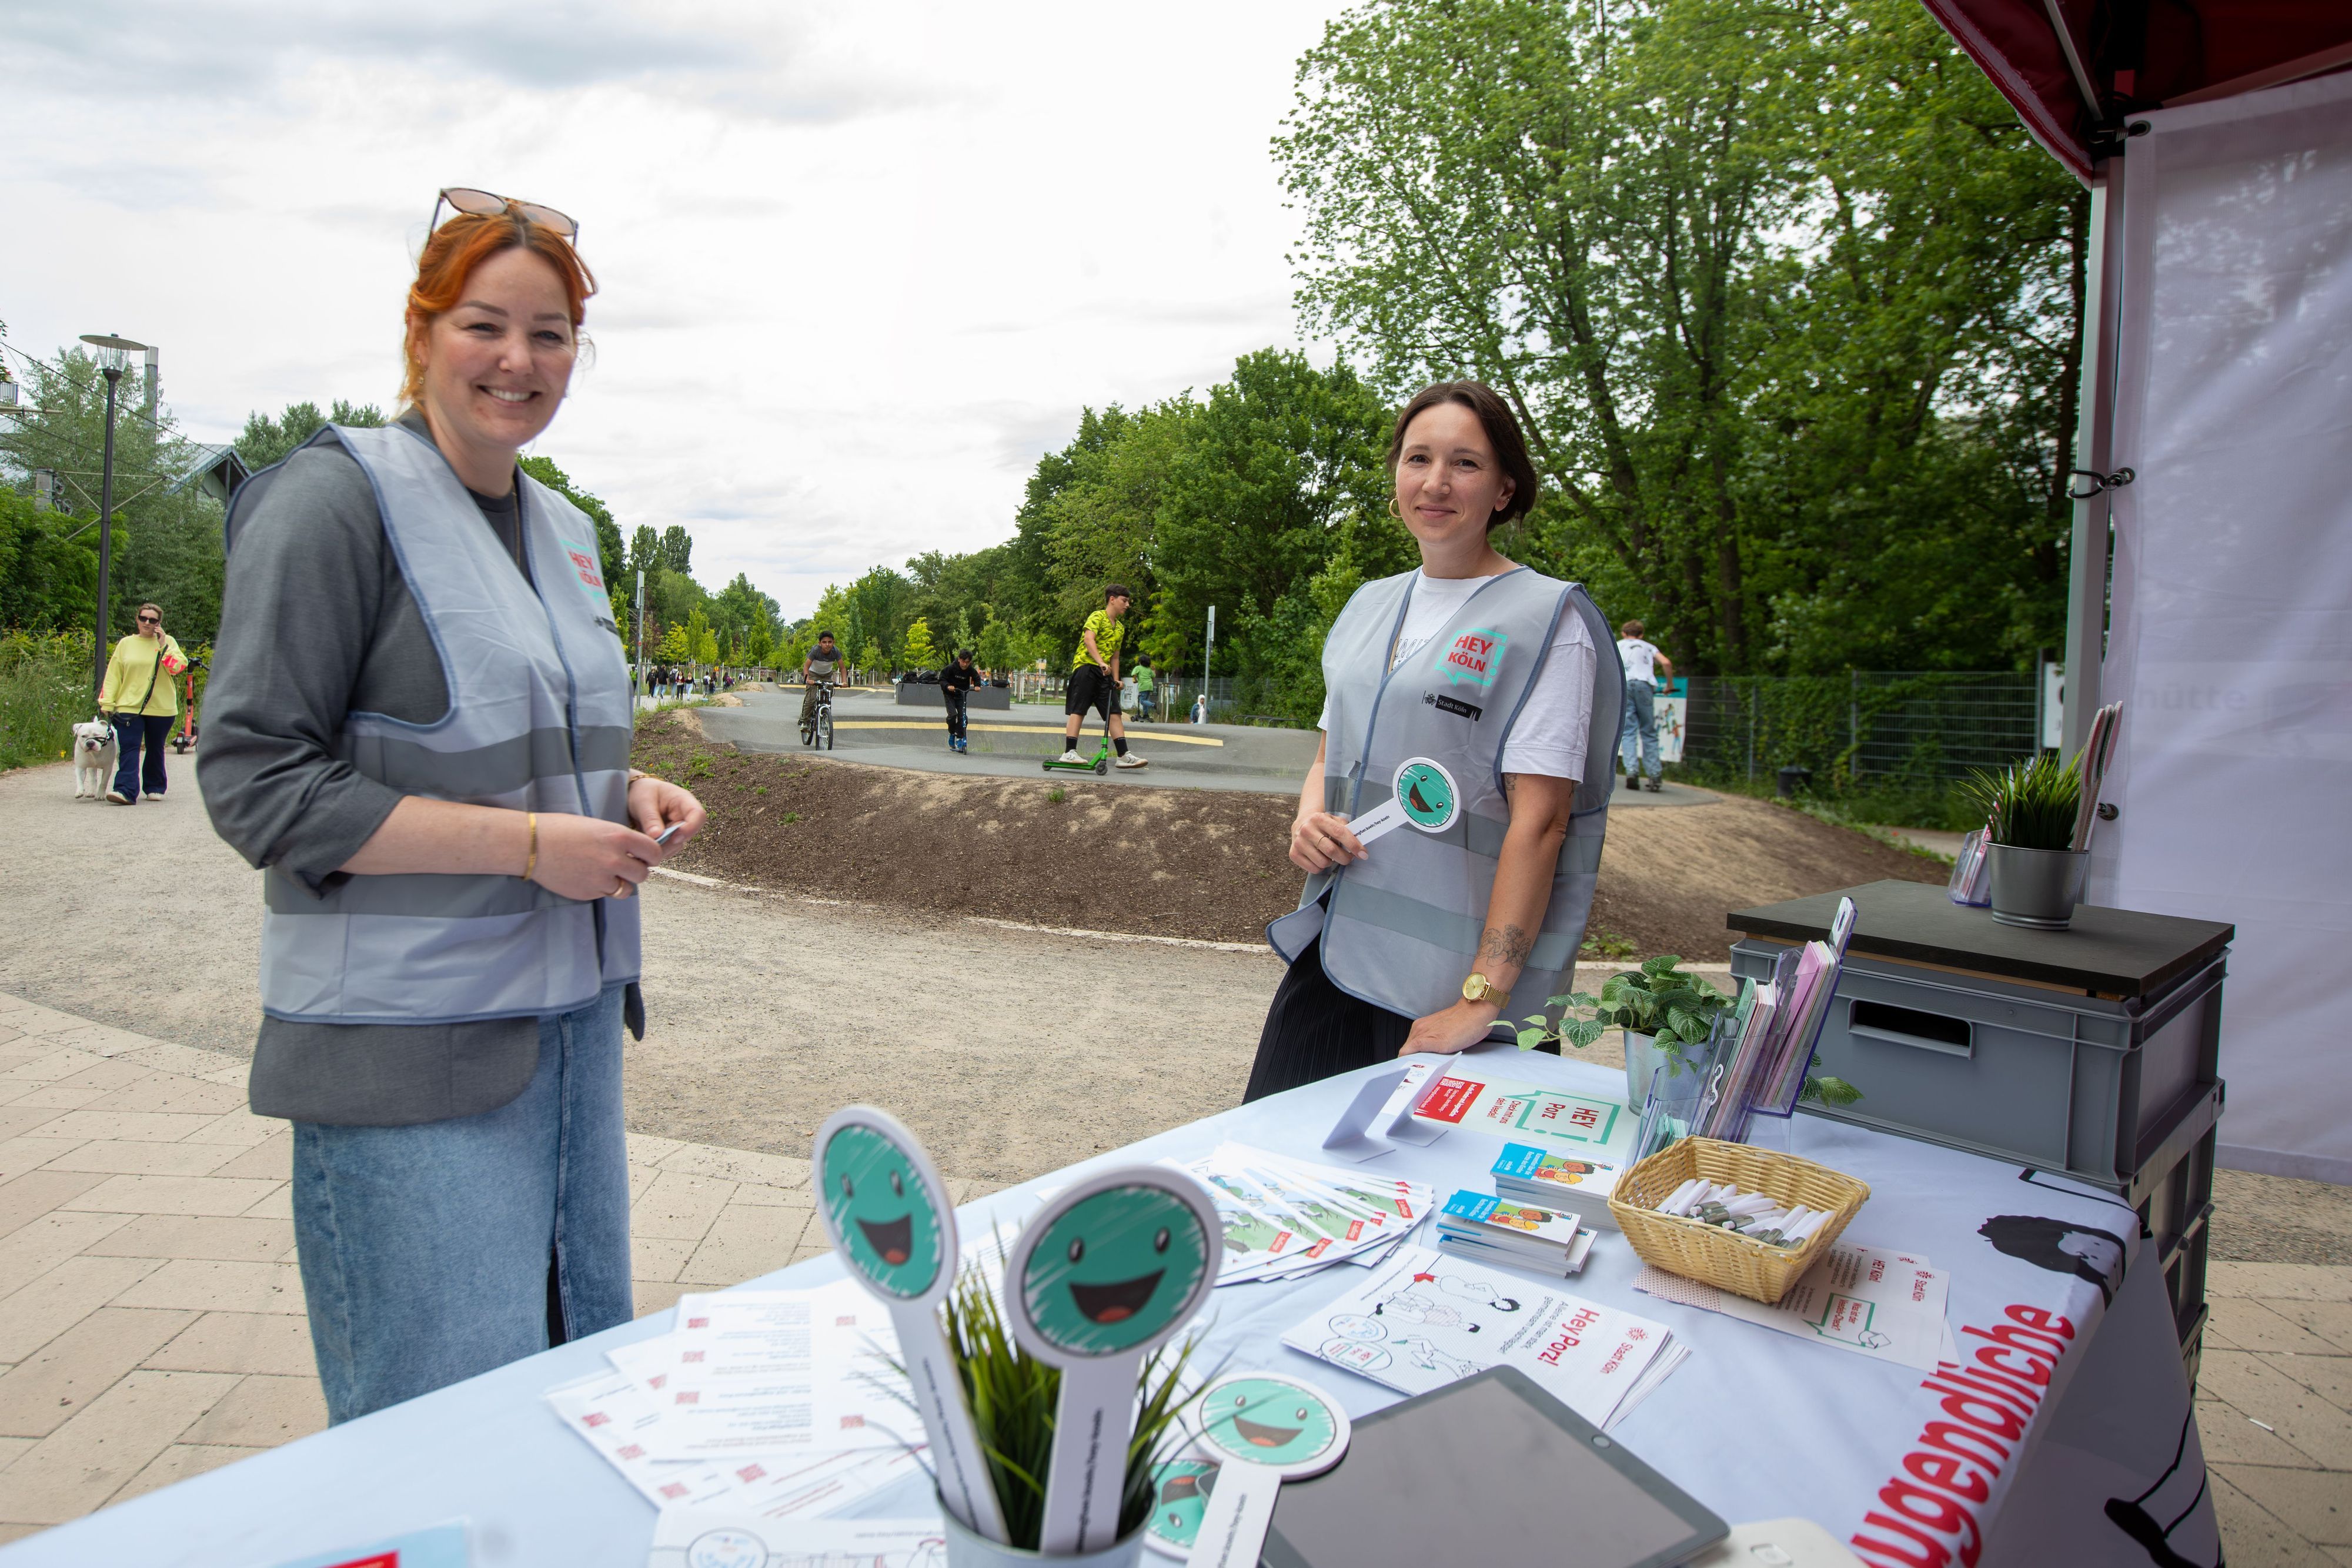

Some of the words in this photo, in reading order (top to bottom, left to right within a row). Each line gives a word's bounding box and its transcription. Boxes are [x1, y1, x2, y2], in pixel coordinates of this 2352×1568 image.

[568, 551, 594, 571] HEY
[1455, 635, 1493, 655] HEY
[1448, 651, 1486, 673] KÖLN
[1437, 698, 1454, 710] Stadt
[1454, 704, 1467, 714] Köln
[1494, 1097, 1507, 1105] dein
[1506, 1100, 1522, 1111] Check
[1541, 1102, 1566, 1119] Porz
[1568, 1107, 1600, 1128] HEY
[1871, 1258, 1886, 1271] HEY
[1867, 1269, 1883, 1283] Köln!
[1913, 1278, 1927, 1292] Stadt
[1911, 1290, 1925, 1302] Köln
[1525, 1295, 1555, 1327] gemeinsam
[1548, 1300, 1570, 1320] Alleine
[1851, 1301, 1862, 1312] Was
[1559, 1307, 1601, 1336] Hey
[1847, 1315, 1858, 1324] der
[1536, 1333, 1581, 1366] Porz!
[1610, 1342, 1634, 1362] Stadt
[1599, 1359, 1621, 1376] Köln
[1850, 1303, 2075, 1568] ugendliche
